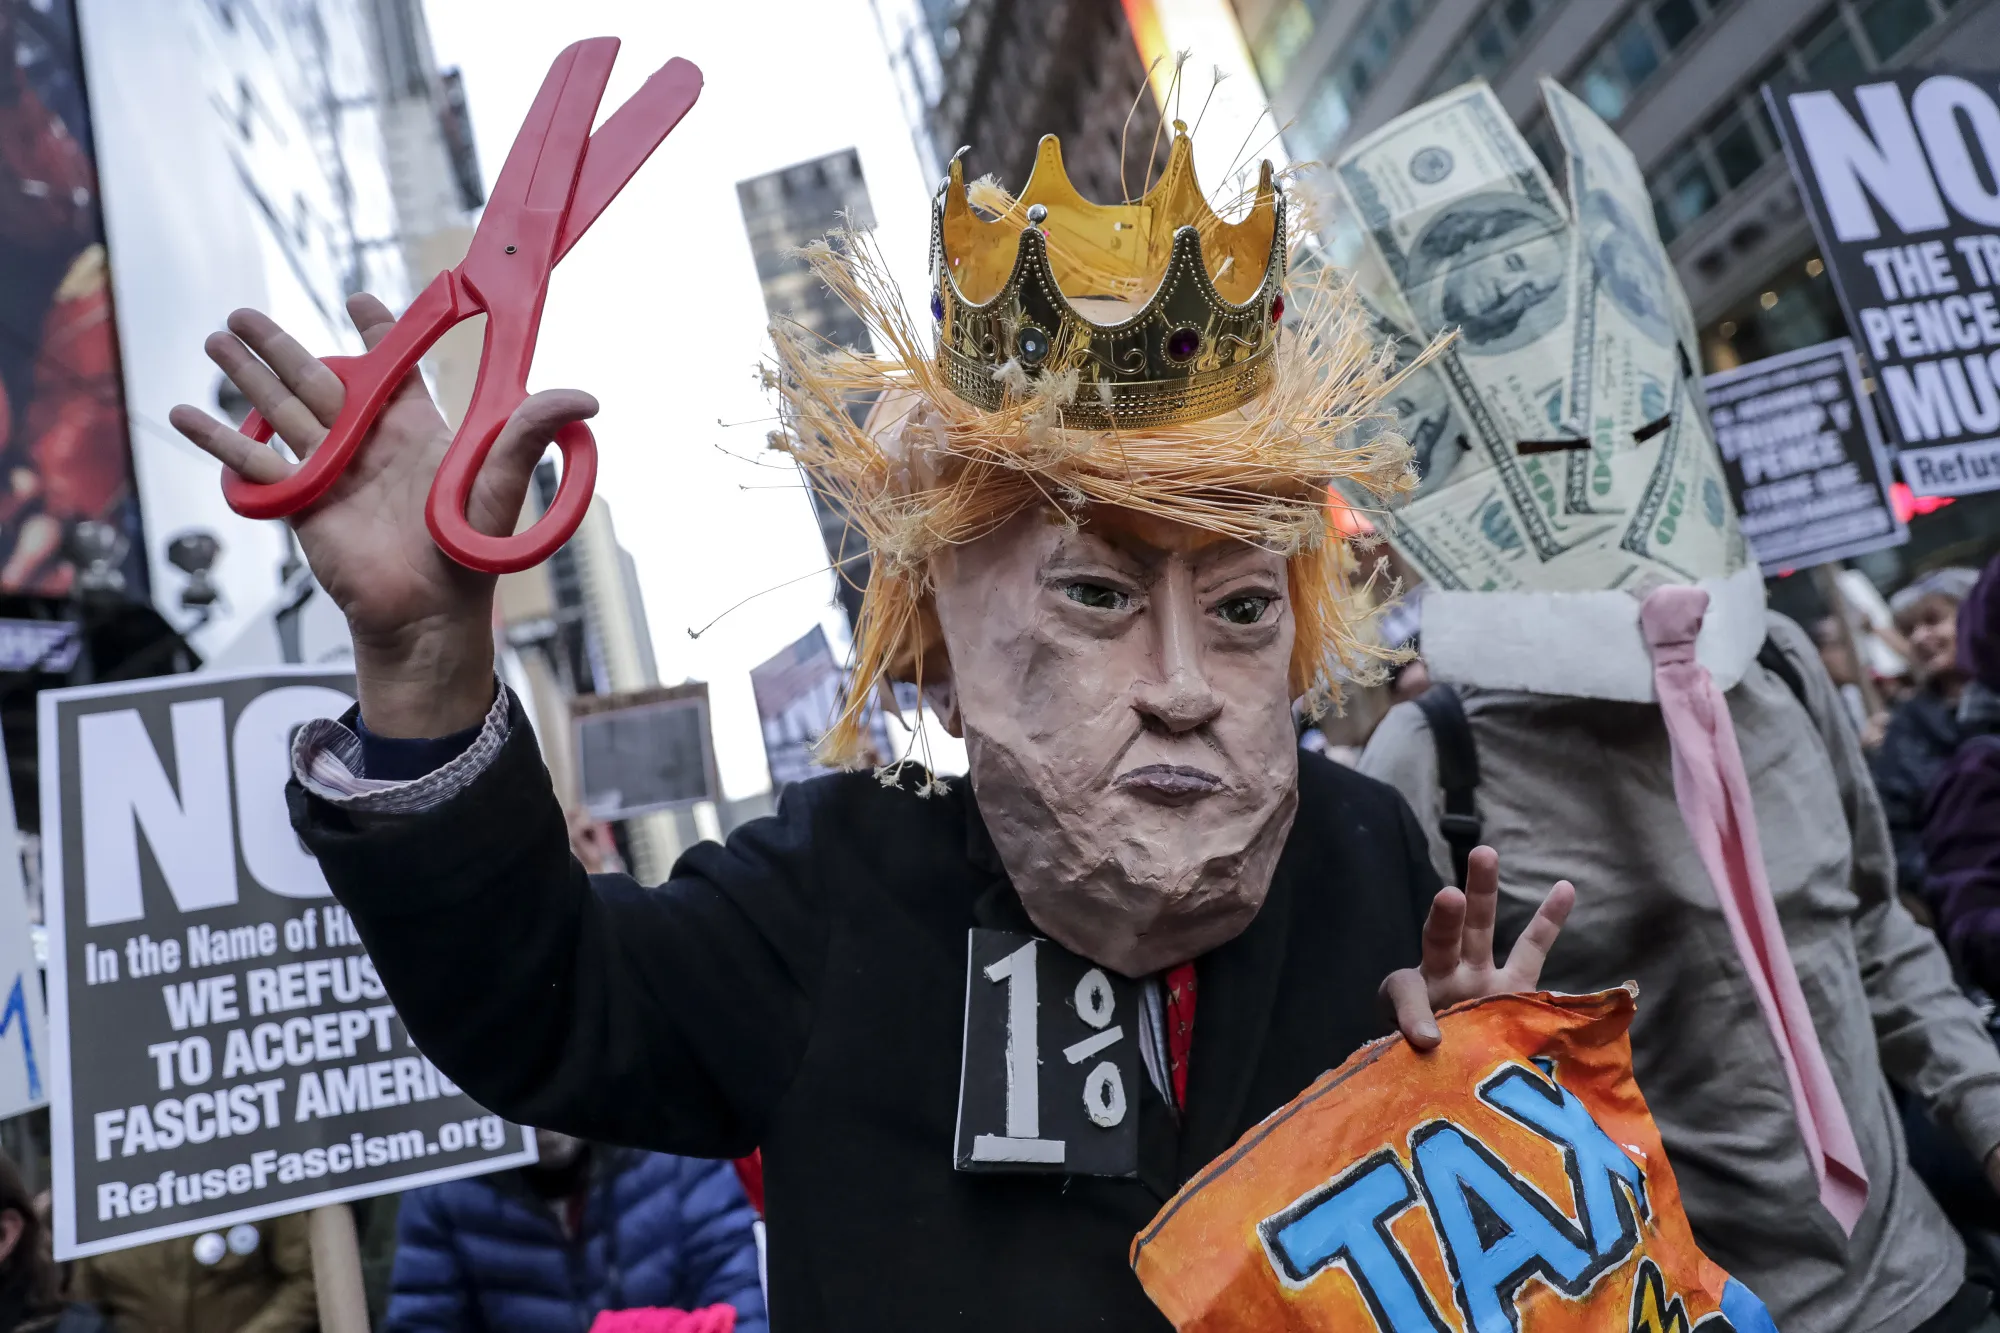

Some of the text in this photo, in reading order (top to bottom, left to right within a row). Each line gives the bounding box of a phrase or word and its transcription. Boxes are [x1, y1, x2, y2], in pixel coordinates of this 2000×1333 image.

[1787, 75, 2000, 243] NO
[1863, 240, 1960, 301] THE
[1860, 290, 2000, 362] PENCE
[85, 942, 120, 986] In
[125, 933, 182, 979] the
[186, 923, 277, 969] Name
[283, 906, 318, 952] of
[162, 973, 240, 1032] WE
[148, 1005, 396, 1091] TO ACCEPT
[971, 938, 1127, 1163] 1%
[93, 1077, 286, 1162] FASCIST
[96, 1114, 506, 1212] RefuseFascism.org
[1256, 1055, 1653, 1333] TAX
